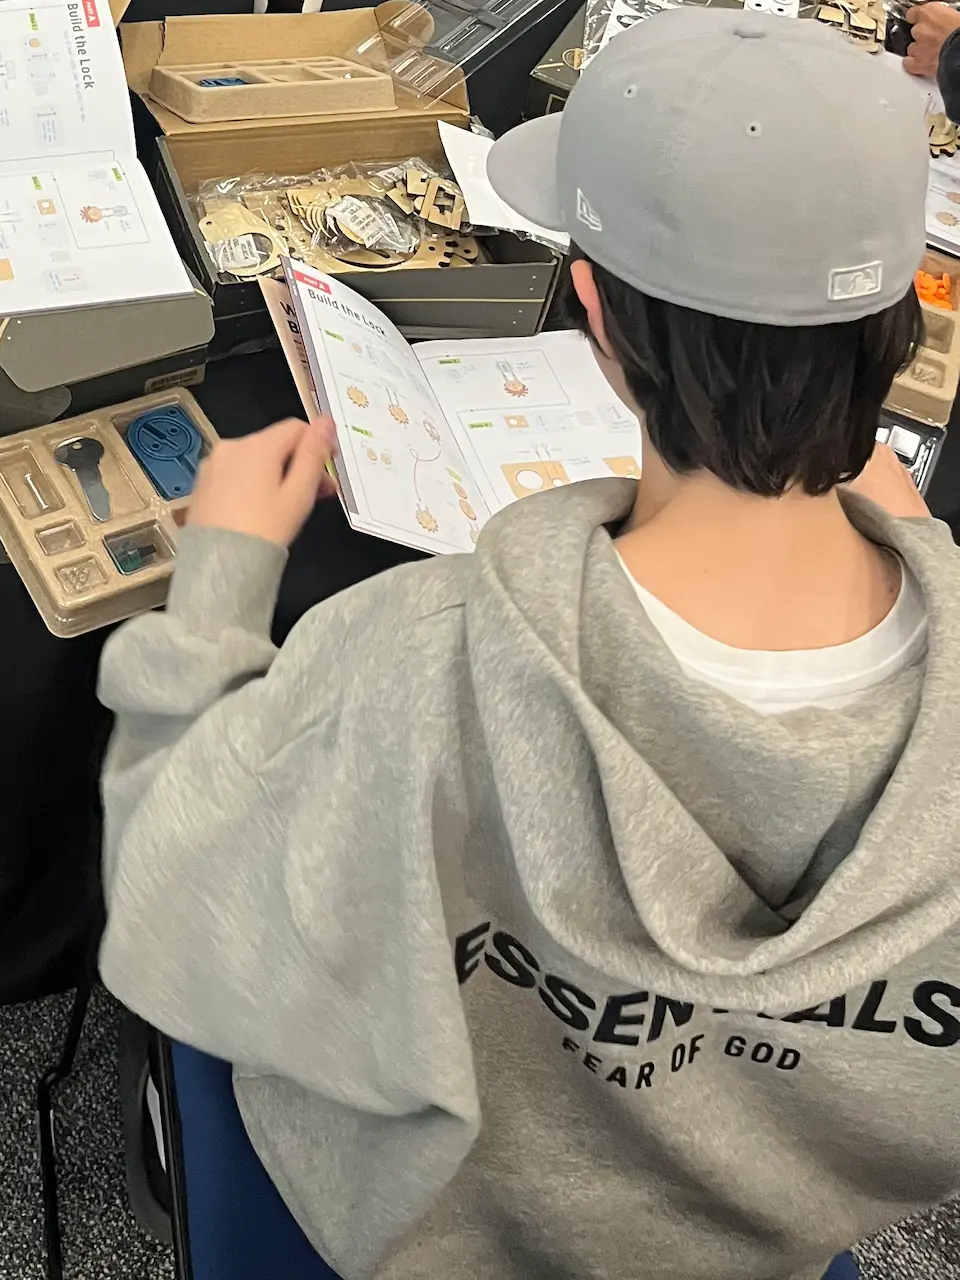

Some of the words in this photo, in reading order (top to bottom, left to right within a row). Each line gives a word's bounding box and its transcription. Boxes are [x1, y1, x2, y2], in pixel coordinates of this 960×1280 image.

[67, 3, 84, 33] Build
[74, 35, 88, 56] the
[79, 58, 95, 90] Lock
[308, 288, 339, 310] Build
[341, 303, 361, 322] the
[455, 921, 960, 1047] ESSENALS
[562, 1037, 655, 1089] FEAR
[671, 1034, 705, 1073] OF
[724, 1036, 801, 1070] GOD
